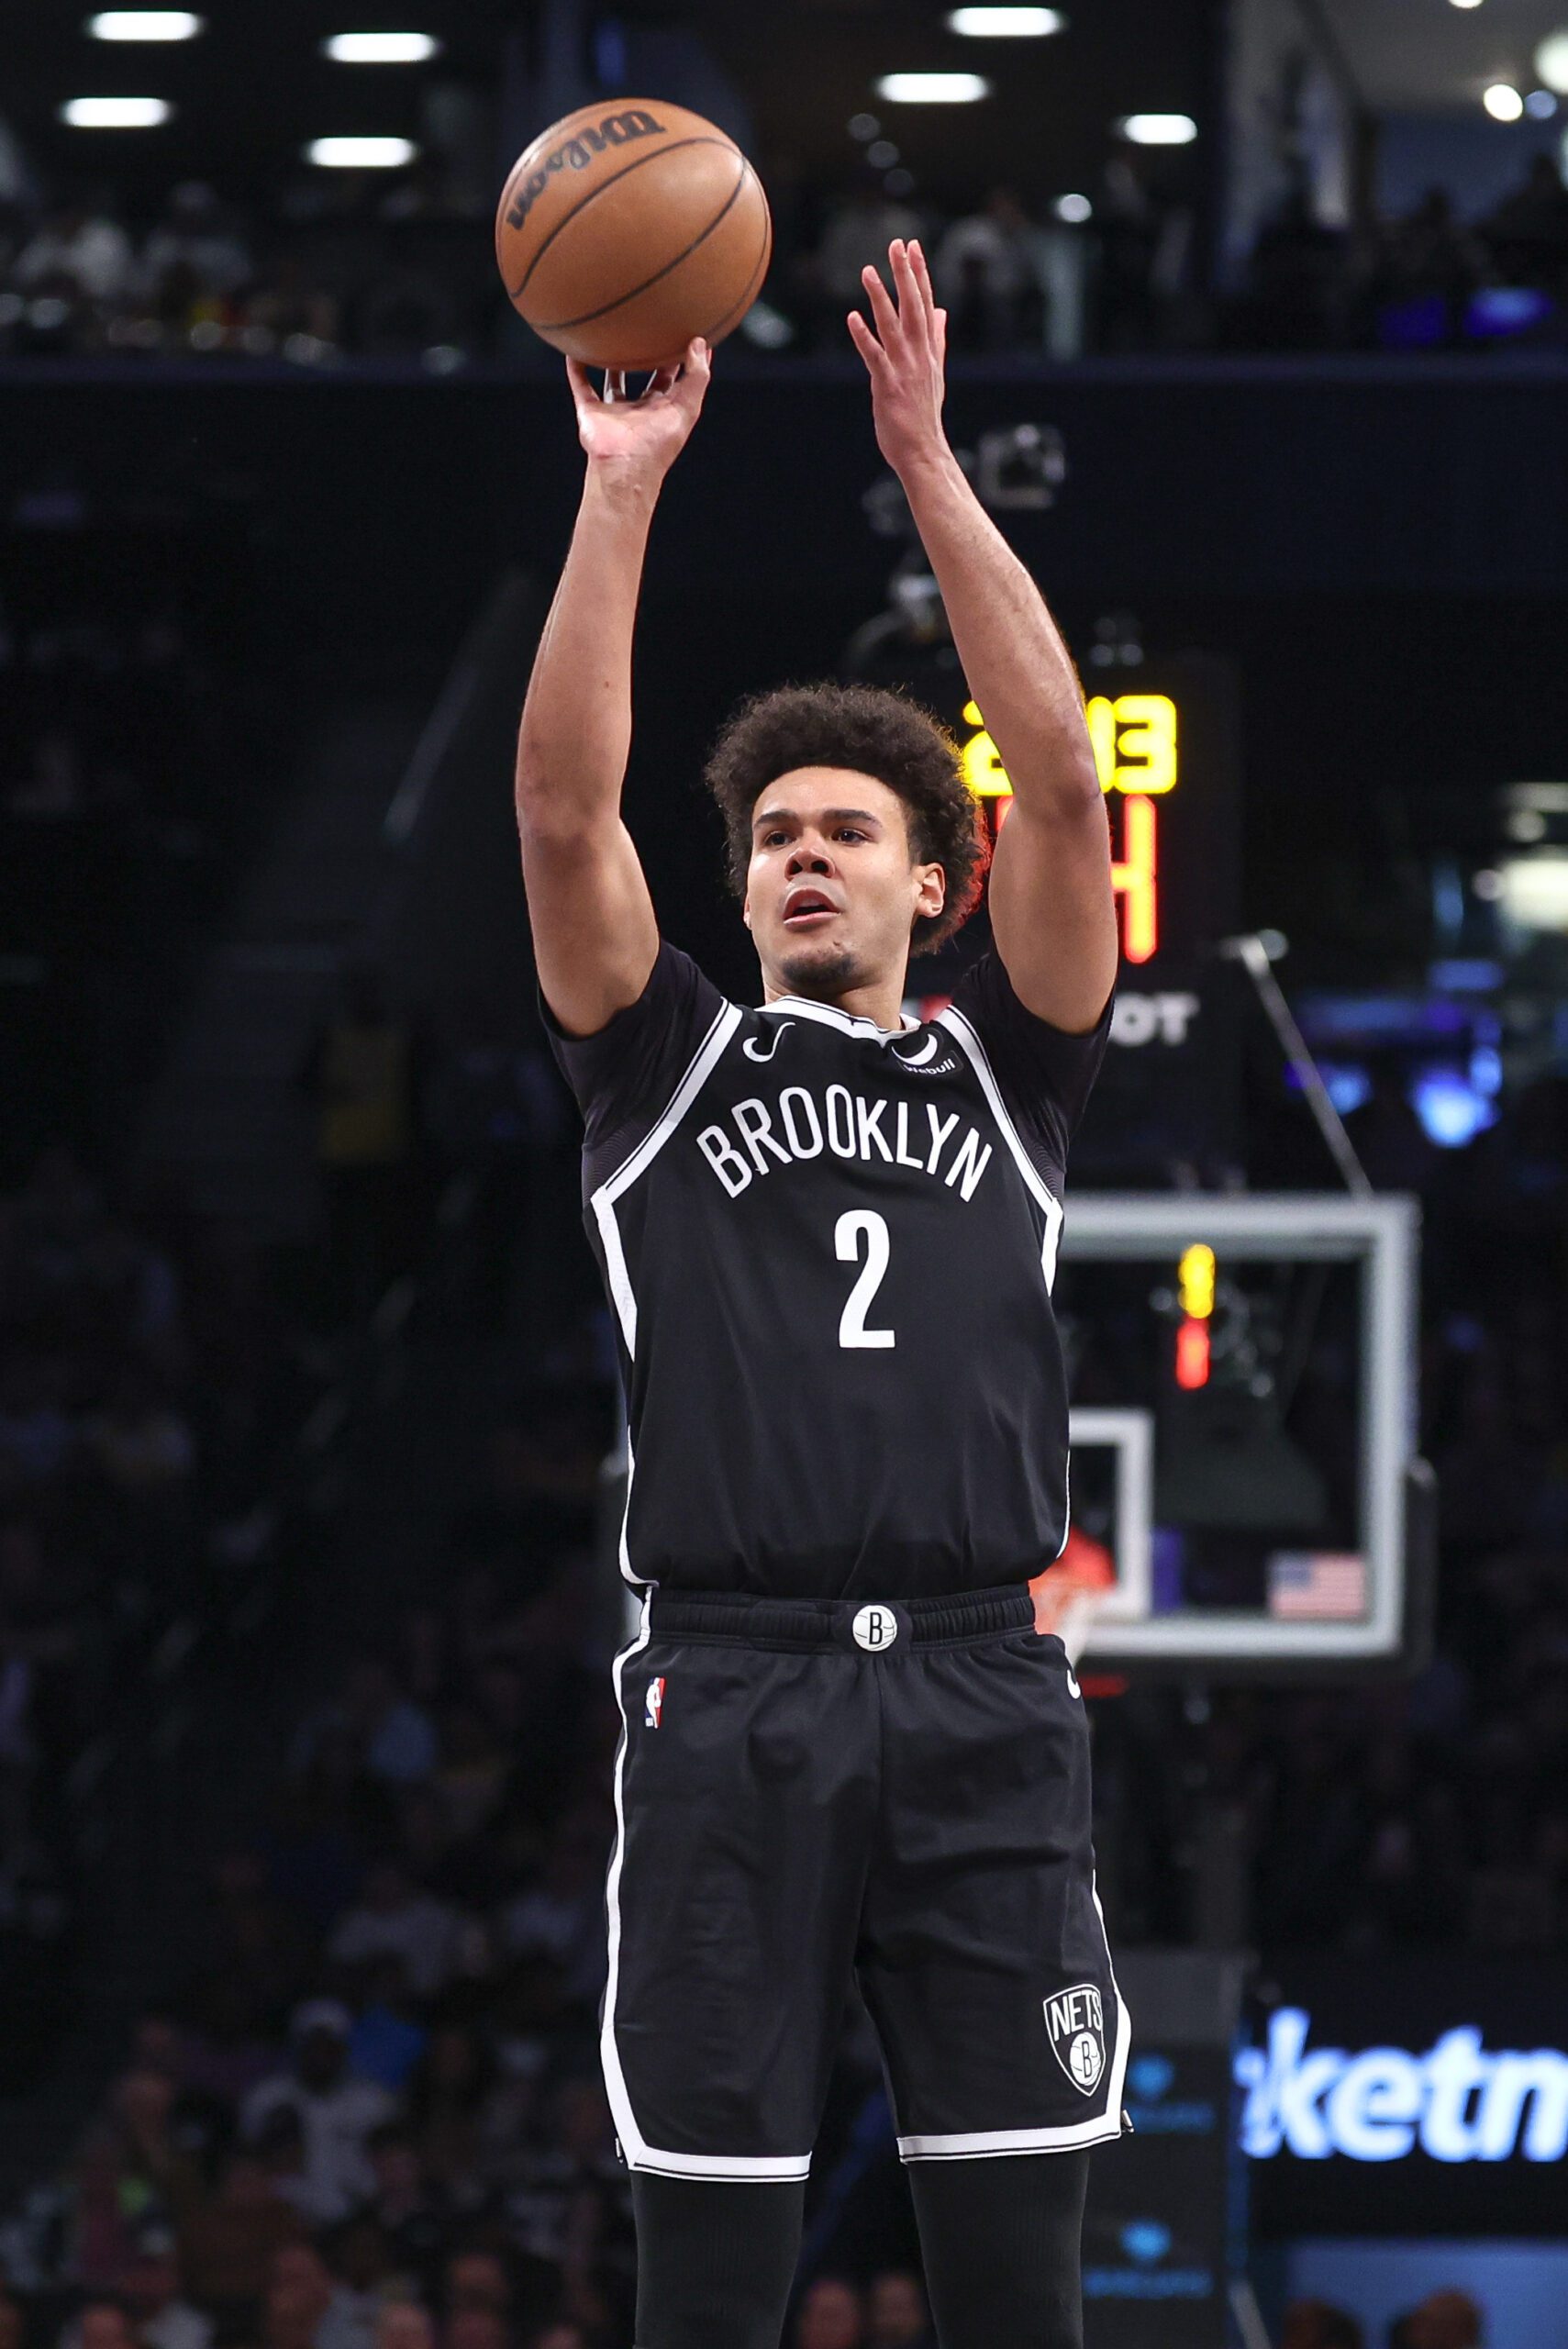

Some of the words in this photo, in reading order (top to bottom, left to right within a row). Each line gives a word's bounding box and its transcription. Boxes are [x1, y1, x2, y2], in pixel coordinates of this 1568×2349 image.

[695, 1084, 993, 1203] BROOKLYN
[834, 1208, 895, 1349] 2
[868, 1611, 884, 1645] B
[1051, 1988, 1102, 2043] NETS
[1081, 2040, 1093, 2079] B
